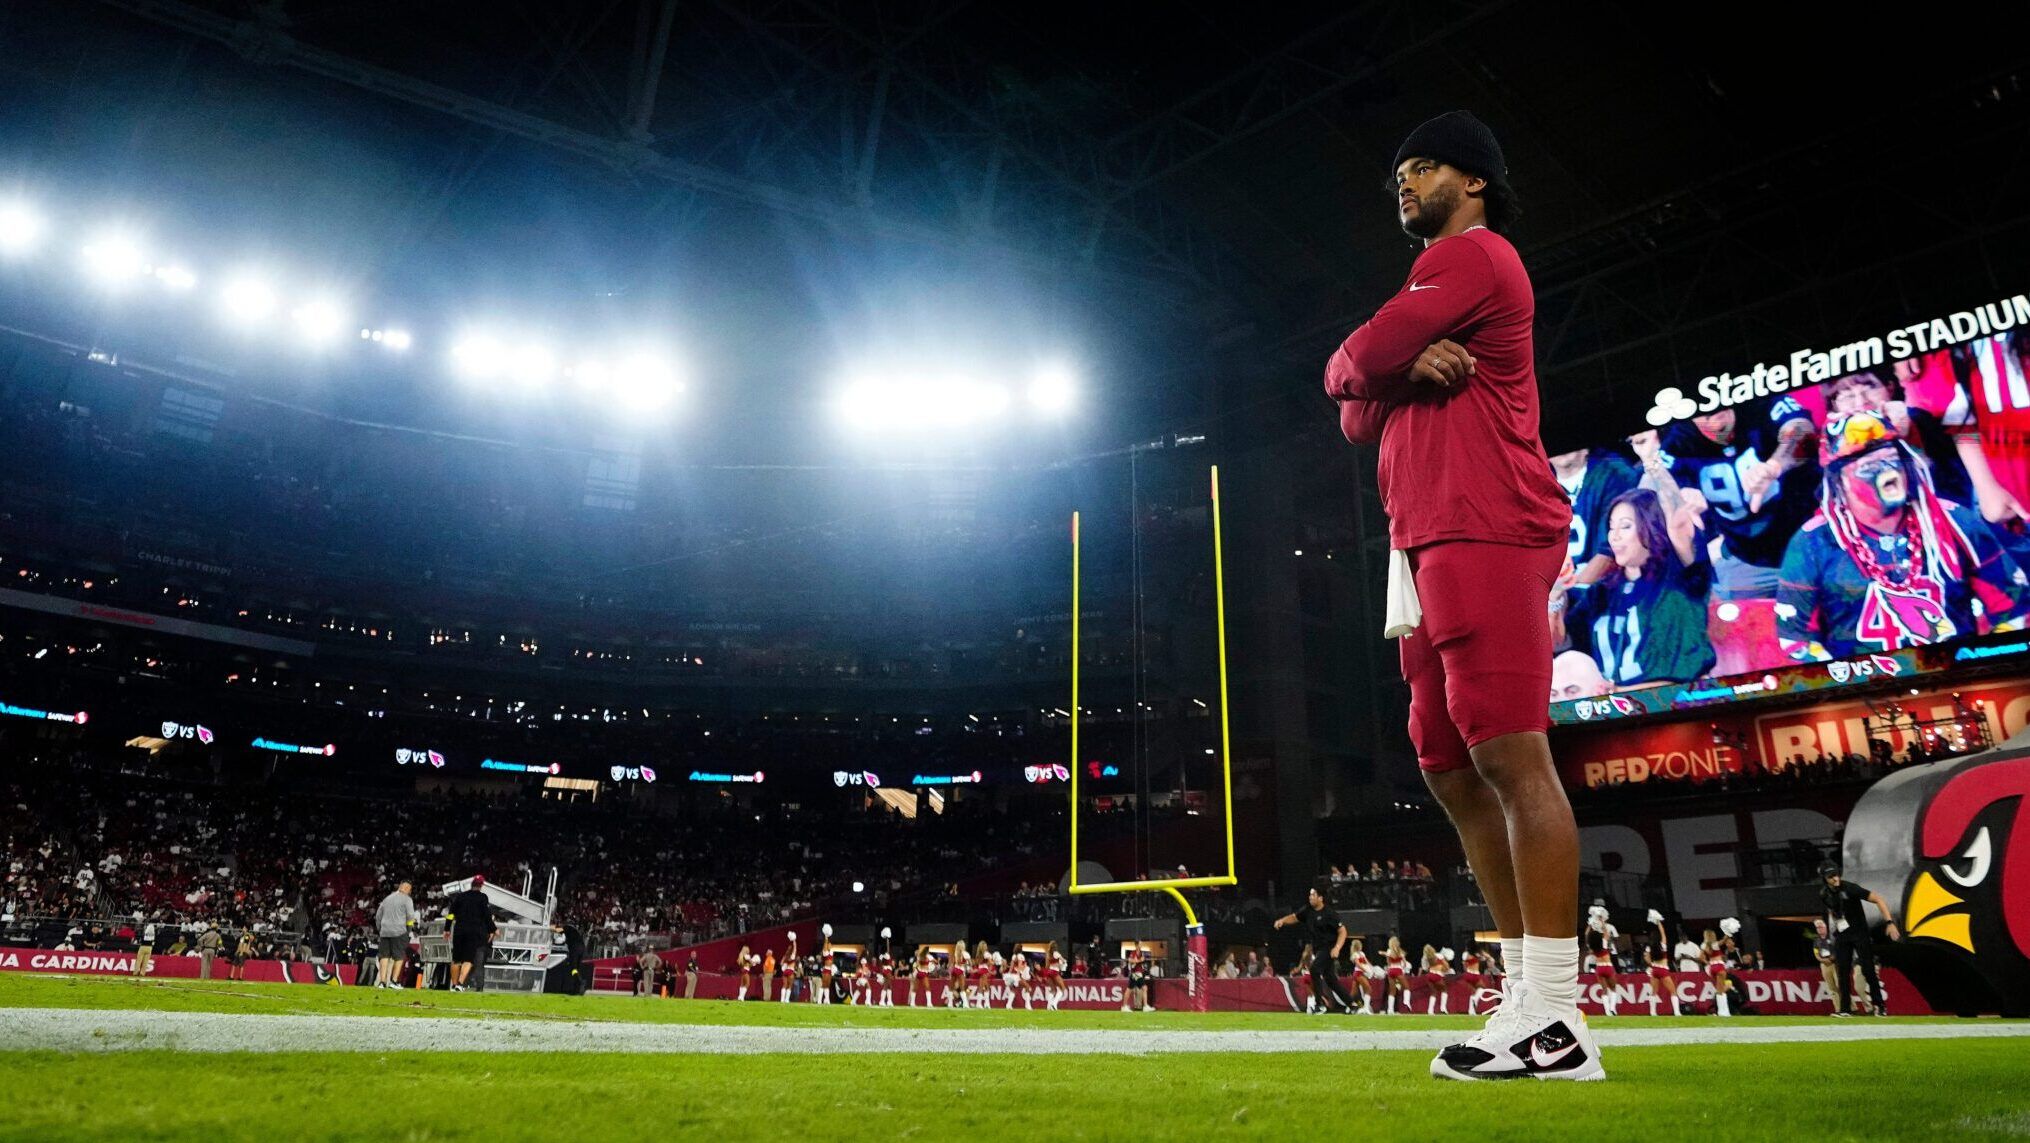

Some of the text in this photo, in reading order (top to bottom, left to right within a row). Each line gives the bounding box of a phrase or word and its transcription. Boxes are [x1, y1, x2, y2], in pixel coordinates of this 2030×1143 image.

[1852, 660, 1873, 676] VS
[1593, 700, 1611, 715] VS
[179, 724, 195, 739] VS
[411, 752, 427, 764] VS
[626, 767, 641, 780] VS
[848, 772, 864, 786] VS
[1040, 765, 1055, 780] VS
